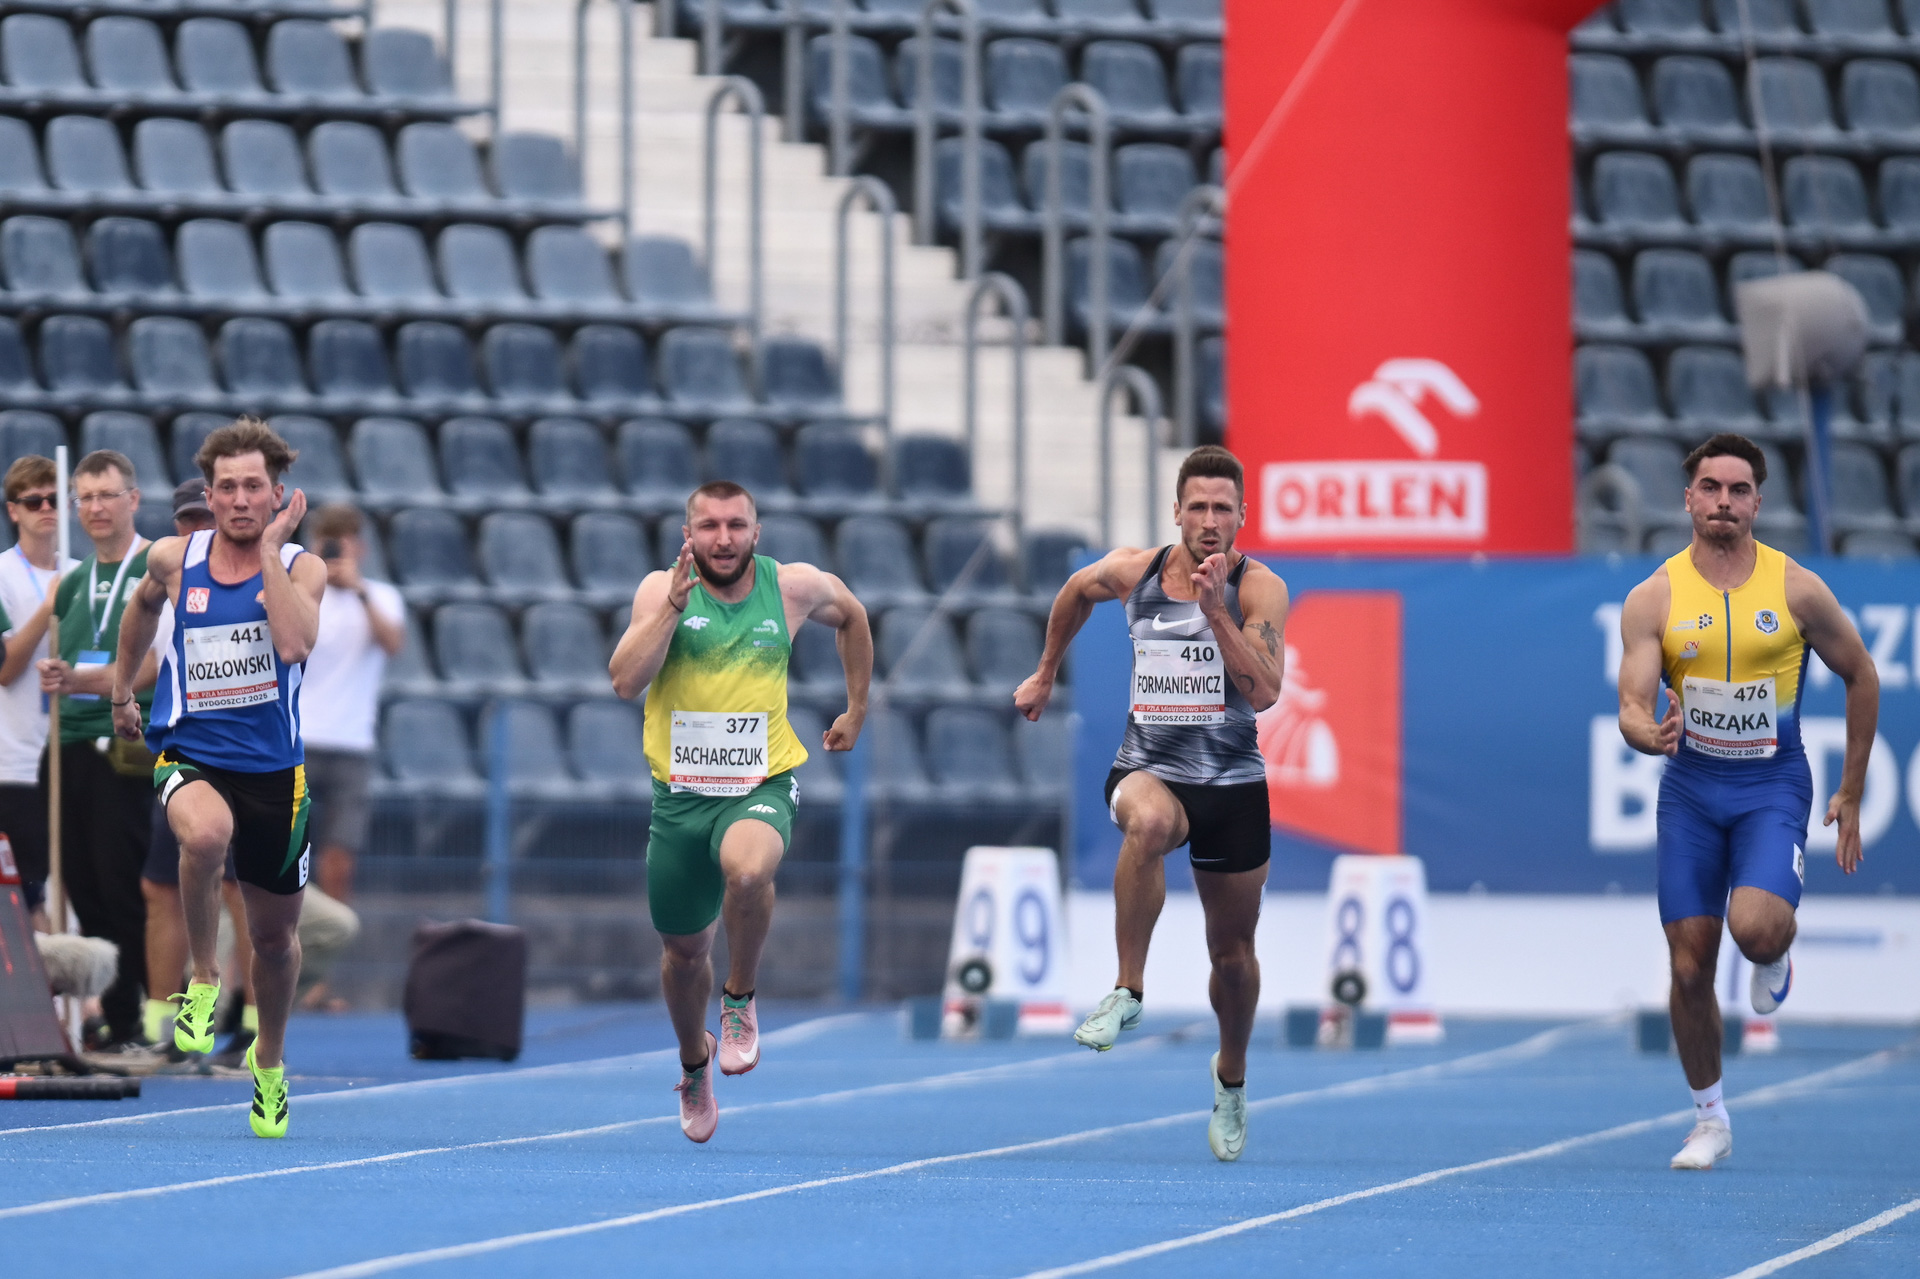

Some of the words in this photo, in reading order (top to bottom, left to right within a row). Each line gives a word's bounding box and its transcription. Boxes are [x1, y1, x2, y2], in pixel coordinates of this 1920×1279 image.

[1275, 476, 1467, 521] ORLEN
[683, 615, 710, 630] 4F
[230, 626, 264, 644] 441
[1180, 646, 1215, 662] 410
[188, 653, 271, 681] KOZŁOWSKI
[202, 690, 216, 698] PZLA
[216, 687, 255, 697] Mistrzostwa
[255, 682, 273, 692] Polski
[1137, 675, 1221, 694] FORMANIEWICZ
[1733, 684, 1768, 701] 476
[199, 697, 247, 708] BYDGOSZCZ
[248, 693, 268, 703] 2025
[726, 717, 760, 734] 377
[1690, 707, 1770, 735] GRZĄKA
[1695, 742, 1742, 756] BYDGOSZCZ
[1744, 748, 1764, 756] 2025
[1713, 739, 1752, 747] Mistrzostwa
[674, 745, 763, 766] SACHARCZUK
[686, 775, 702, 783] PZLA
[703, 776, 743, 784] Mistrzostwa
[744, 776, 763, 784] Polski
[1013, 886, 1051, 986] 9
[1385, 895, 1421, 994] 8
